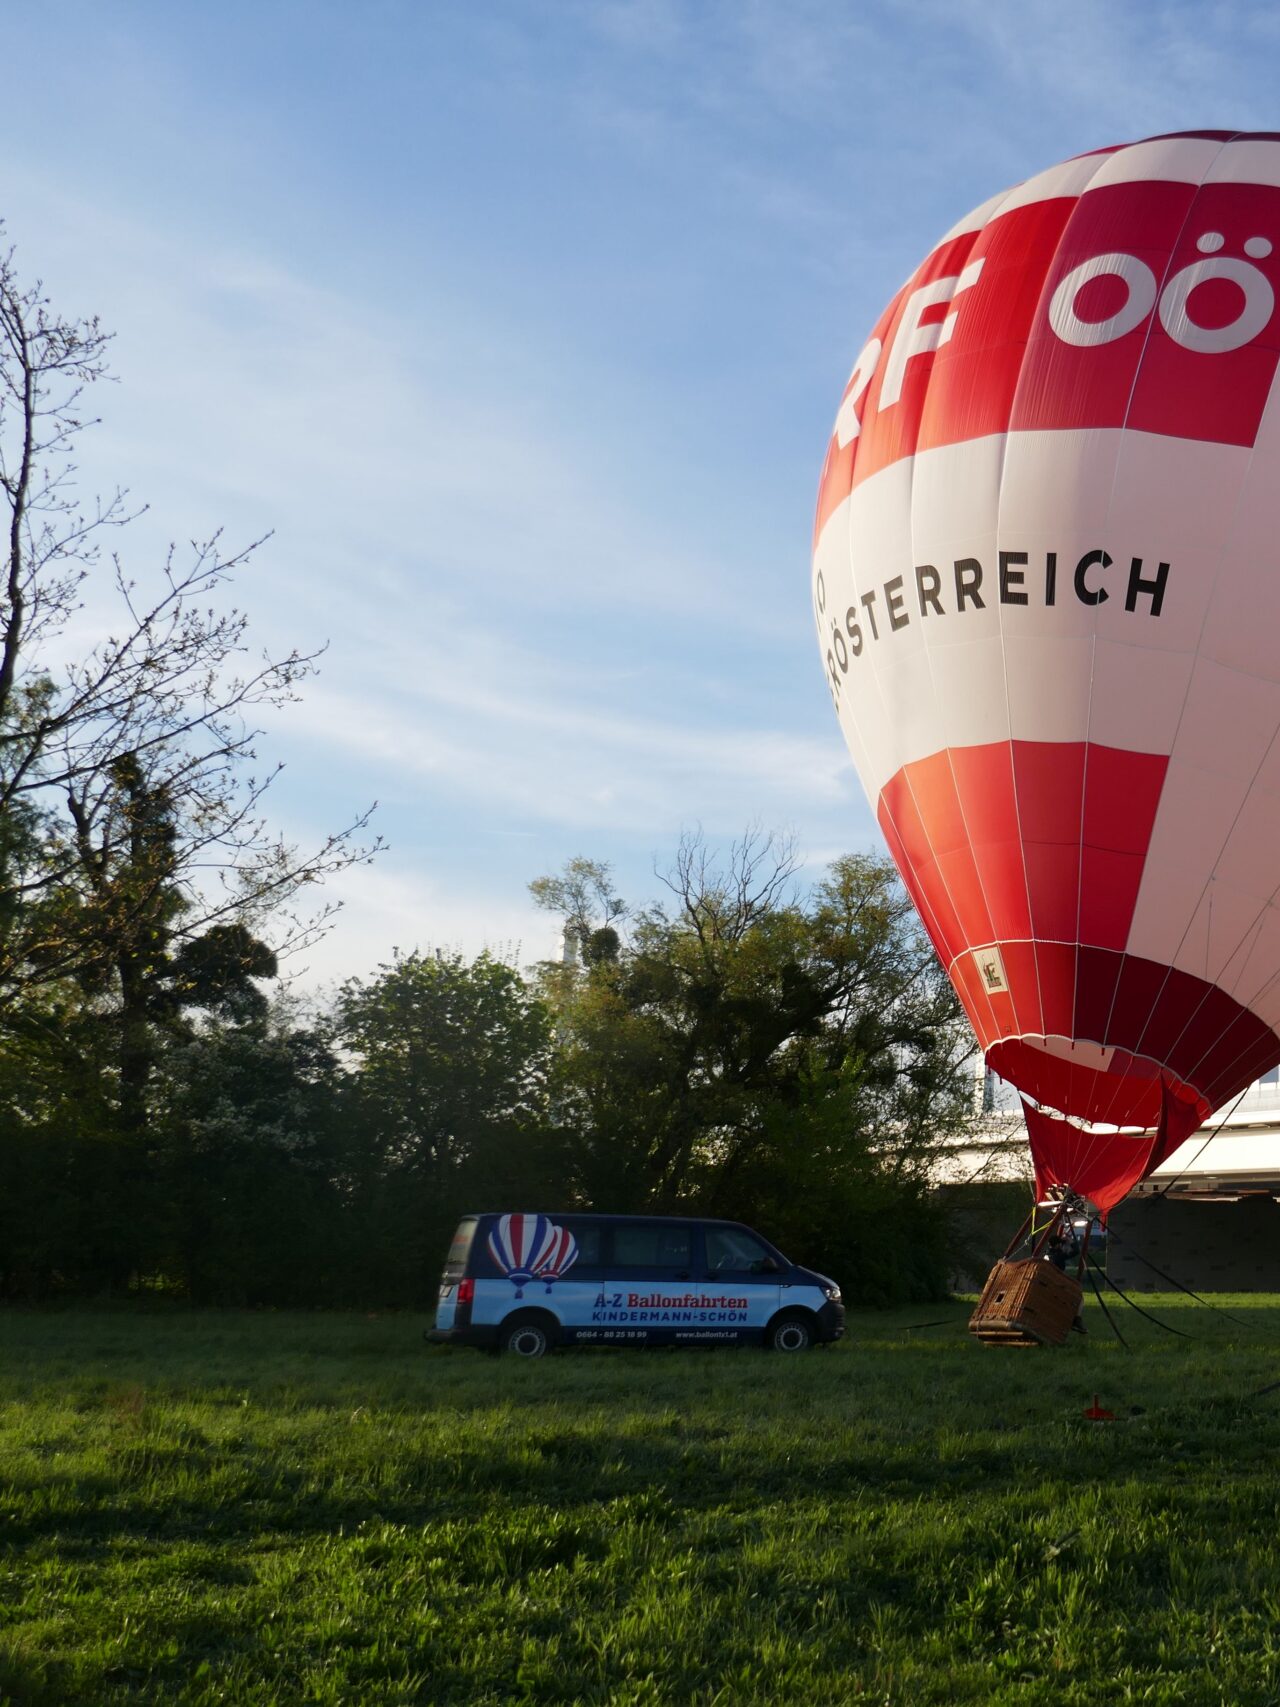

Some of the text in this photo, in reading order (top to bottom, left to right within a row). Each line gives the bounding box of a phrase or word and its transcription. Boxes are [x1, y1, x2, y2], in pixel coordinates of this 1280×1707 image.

[825, 231, 1275, 475] RF OÖ
[827, 549, 1170, 713] RÖSTERREICH
[592, 1309, 748, 1322] KINDERMANN-SCHÖN
[593, 1293, 748, 1309] A-Z Ballonfahrten
